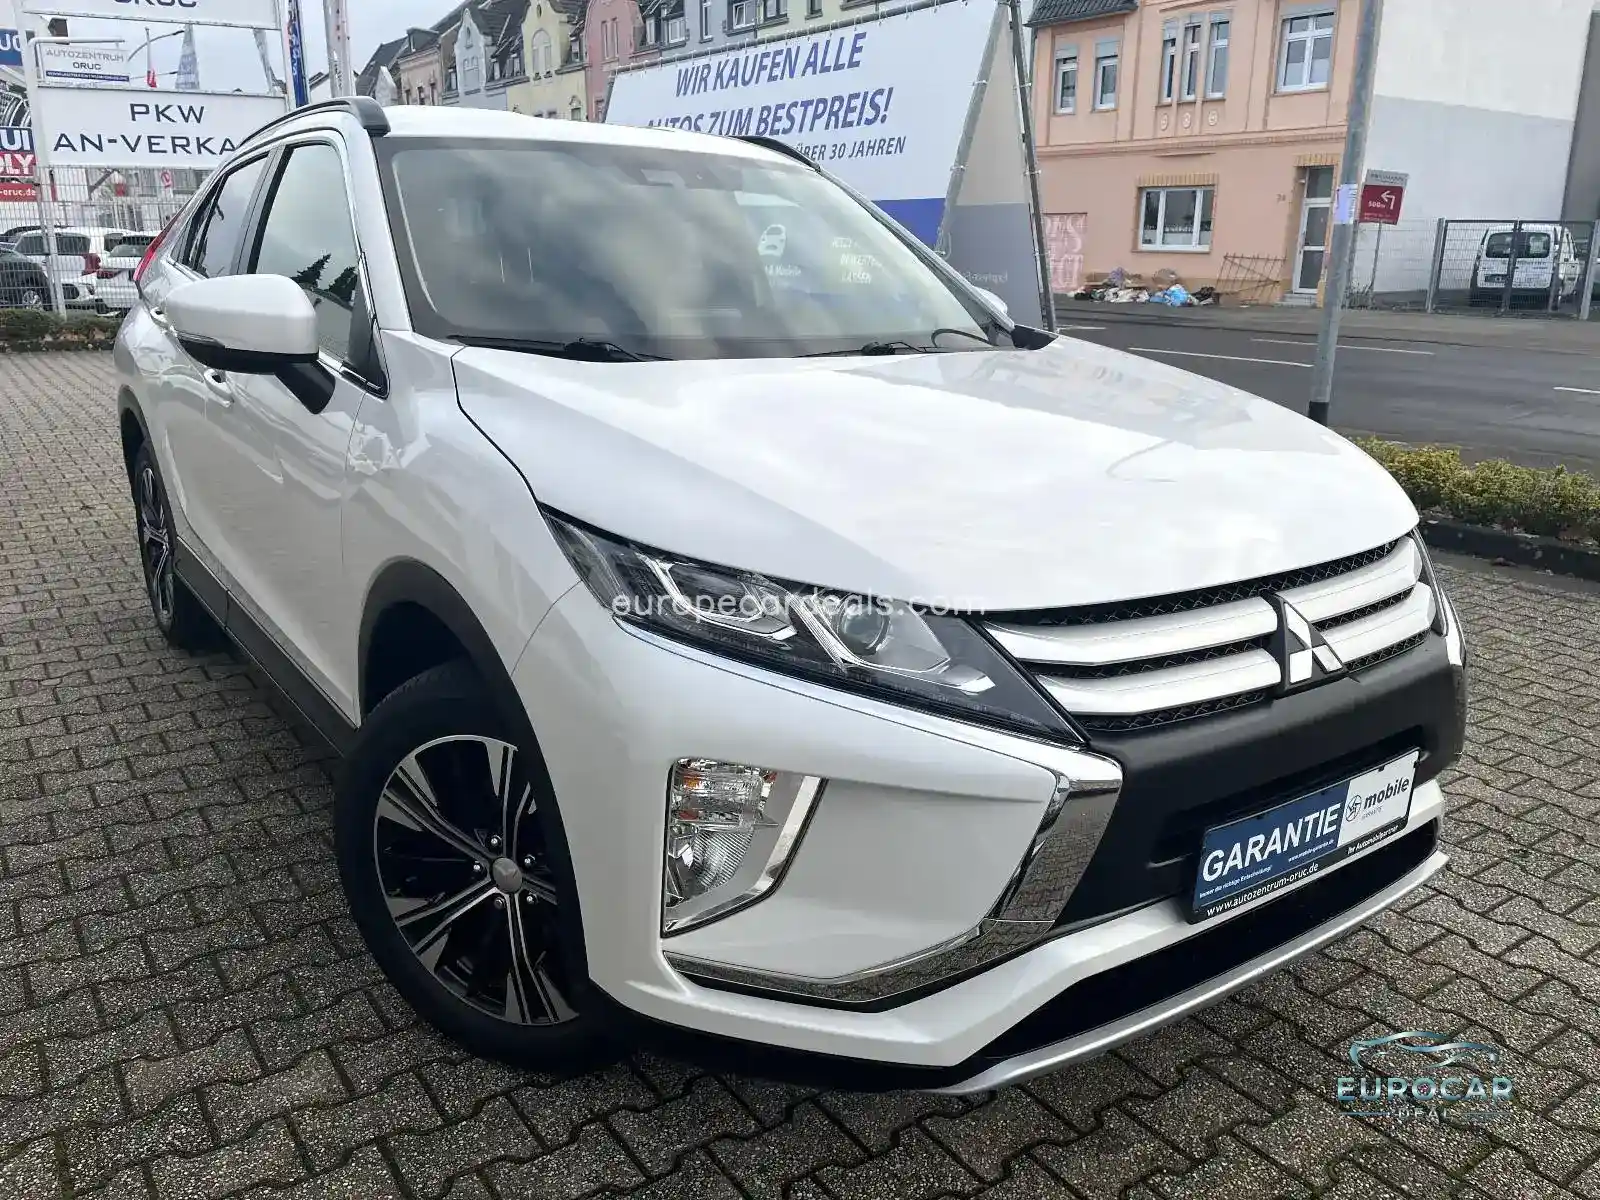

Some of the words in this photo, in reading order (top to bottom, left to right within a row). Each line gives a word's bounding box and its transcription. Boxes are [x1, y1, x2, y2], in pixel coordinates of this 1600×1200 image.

[46, 49, 124, 61] AUTOZENTRUM
[72, 61, 102, 70] ORUC
[676, 64, 711, 97] WIR
[713, 46, 800, 91] KAUFEN
[801, 32, 866, 77] ALLE
[130, 103, 205, 123] PKW
[708, 107, 754, 135] ZUM
[755, 87, 894, 136] BESTPREIS!
[829, 142, 846, 160] 30
[848, 136, 906, 158] JAHREN
[1363, 776, 1409, 810] mobile
[1202, 803, 1341, 882] GARANTIE
[1206, 862, 1319, 917] www.autozentrum-oruc.de
